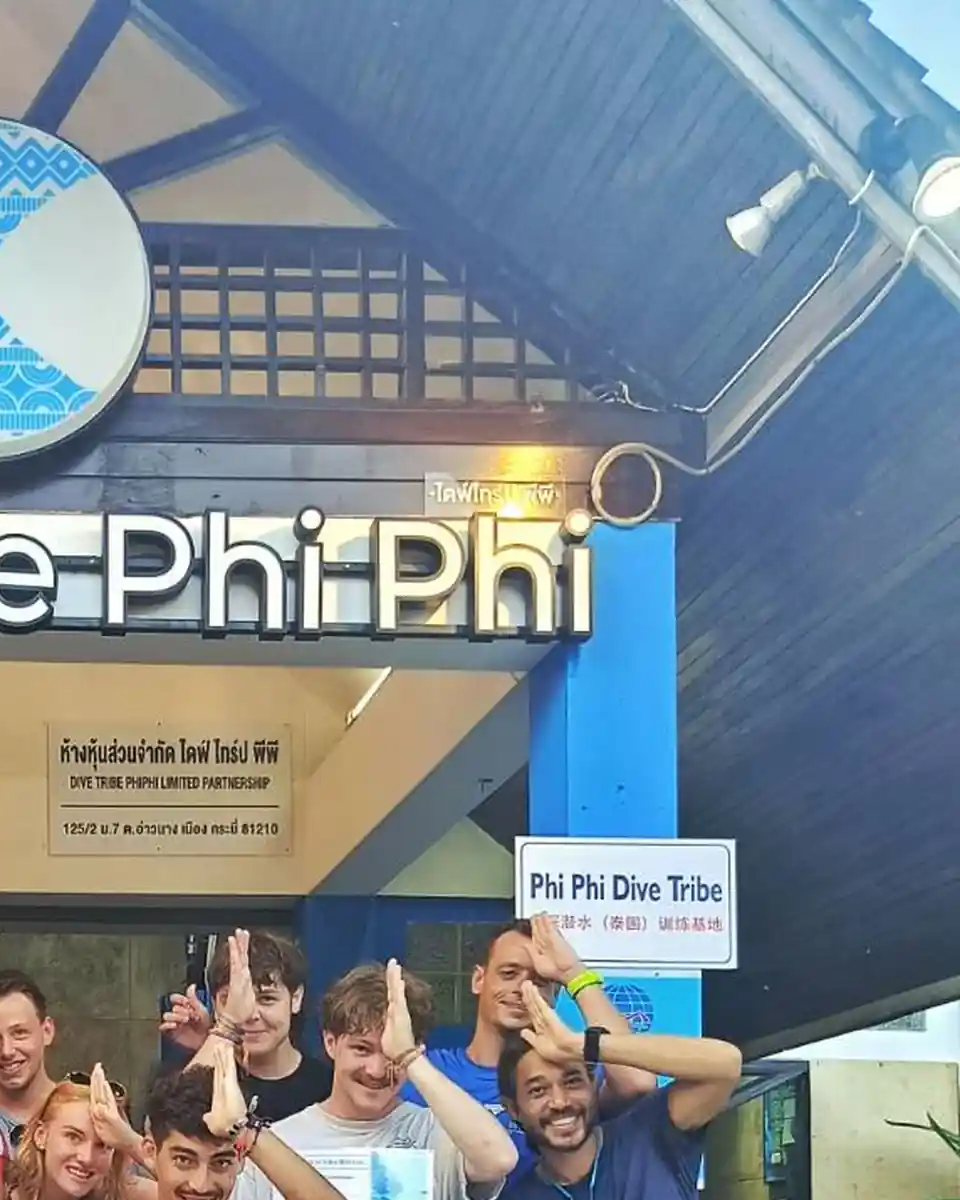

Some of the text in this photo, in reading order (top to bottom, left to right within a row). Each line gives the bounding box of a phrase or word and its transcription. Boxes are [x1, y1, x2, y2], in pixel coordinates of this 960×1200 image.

[102, 506, 325, 640] Phi
[369, 508, 593, 641] Phi
[69, 775, 271, 790] DIVE TRIBE PHIPHI LIMITED PARTNERSHIP
[63, 822, 98, 835] 125/2
[530, 872, 723, 903] Phi Phi Dive Tribe
